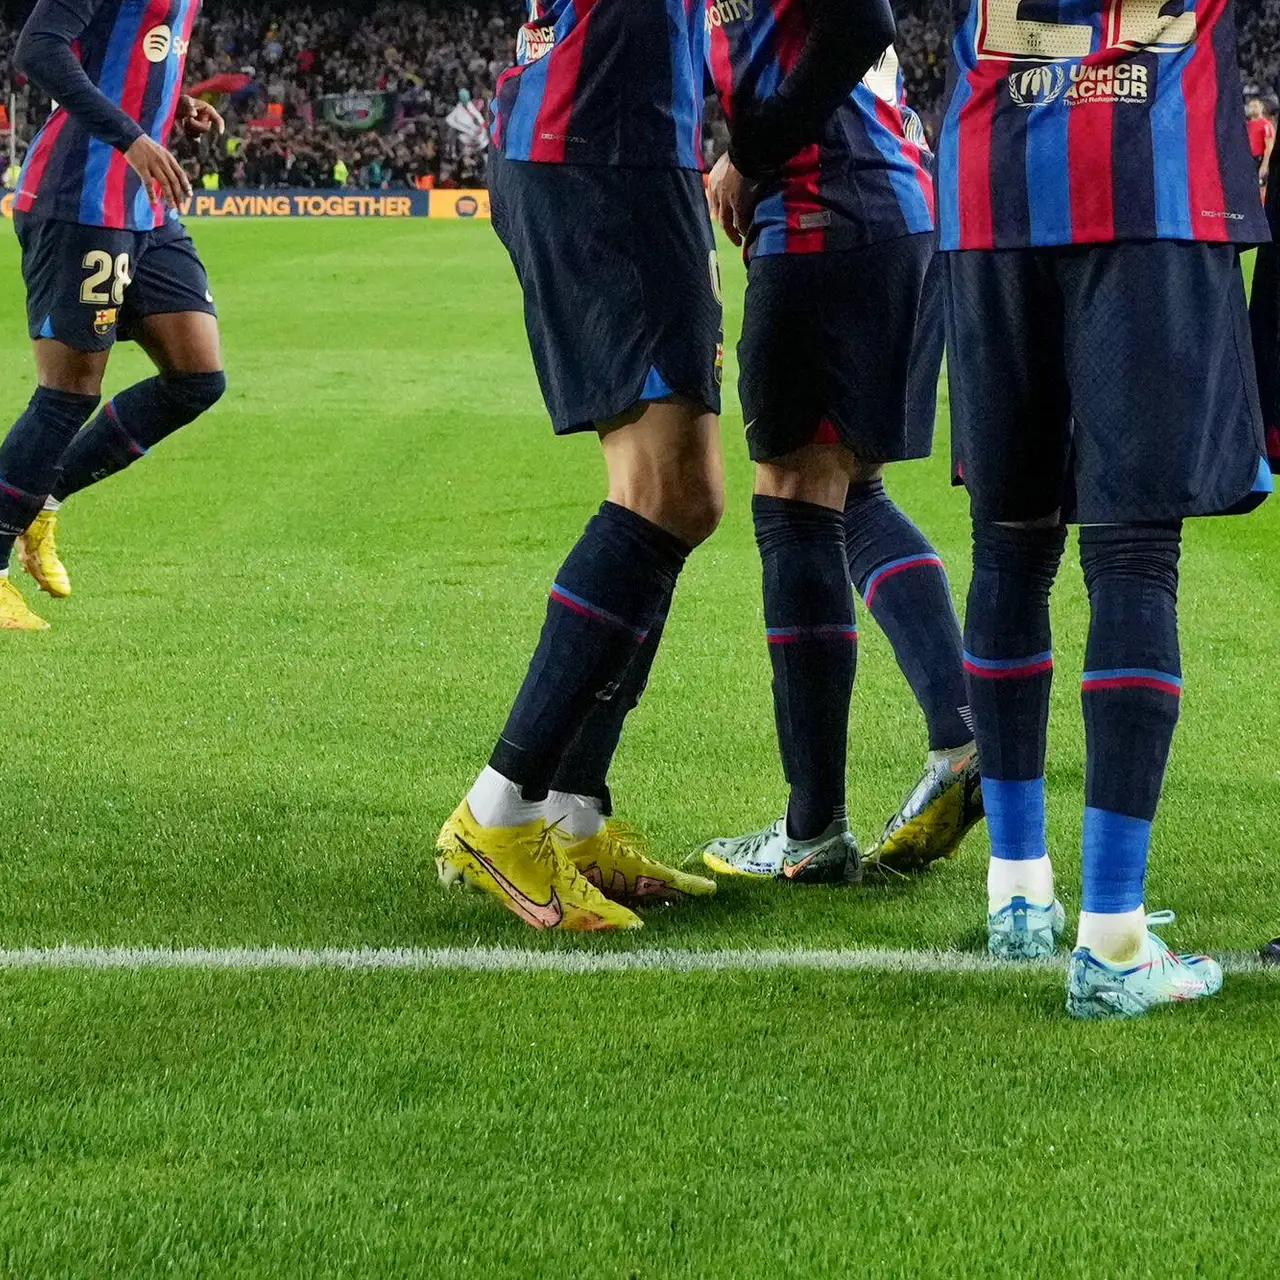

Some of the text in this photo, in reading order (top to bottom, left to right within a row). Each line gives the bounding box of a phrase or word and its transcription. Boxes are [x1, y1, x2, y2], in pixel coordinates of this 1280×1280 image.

[1069, 63, 1148, 82] UNHCR
[1064, 79, 1148, 98] ACNUR
[197, 196, 289, 217] PLAYING
[295, 196, 412, 217] TOGETHER
[79, 249, 132, 305] 28
